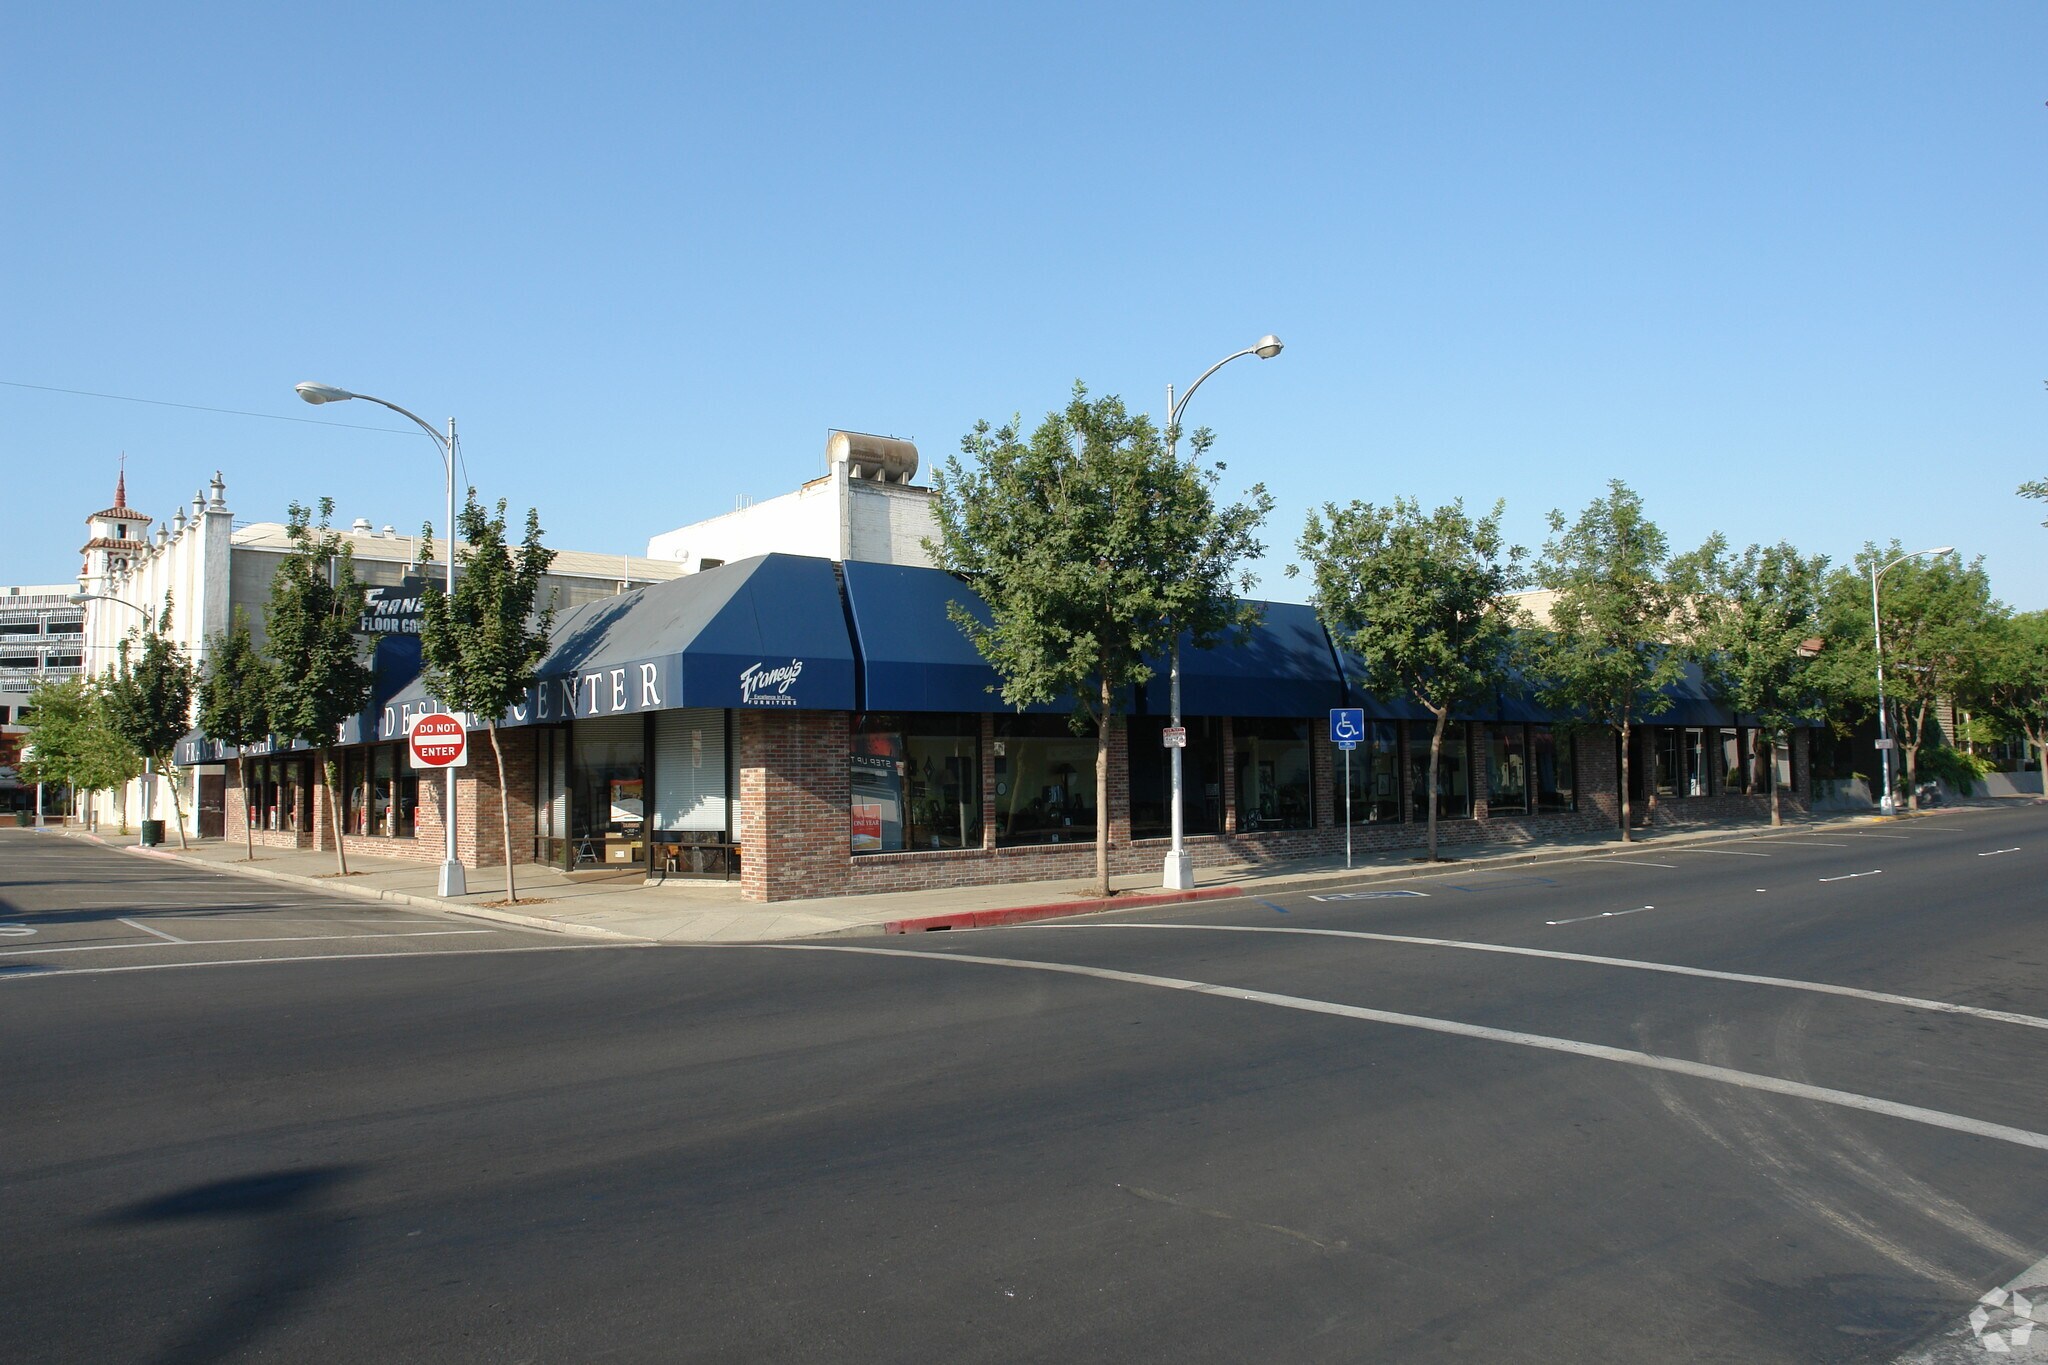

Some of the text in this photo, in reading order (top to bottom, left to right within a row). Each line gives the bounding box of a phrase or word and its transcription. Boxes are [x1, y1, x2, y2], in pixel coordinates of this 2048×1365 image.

[361, 617, 399, 633] FLOOR
[740, 658, 803, 703] Franey's
[513, 662, 661, 721] CENTER
[420, 724, 456, 733] DO NOT
[421, 747, 455, 756] ENTER
